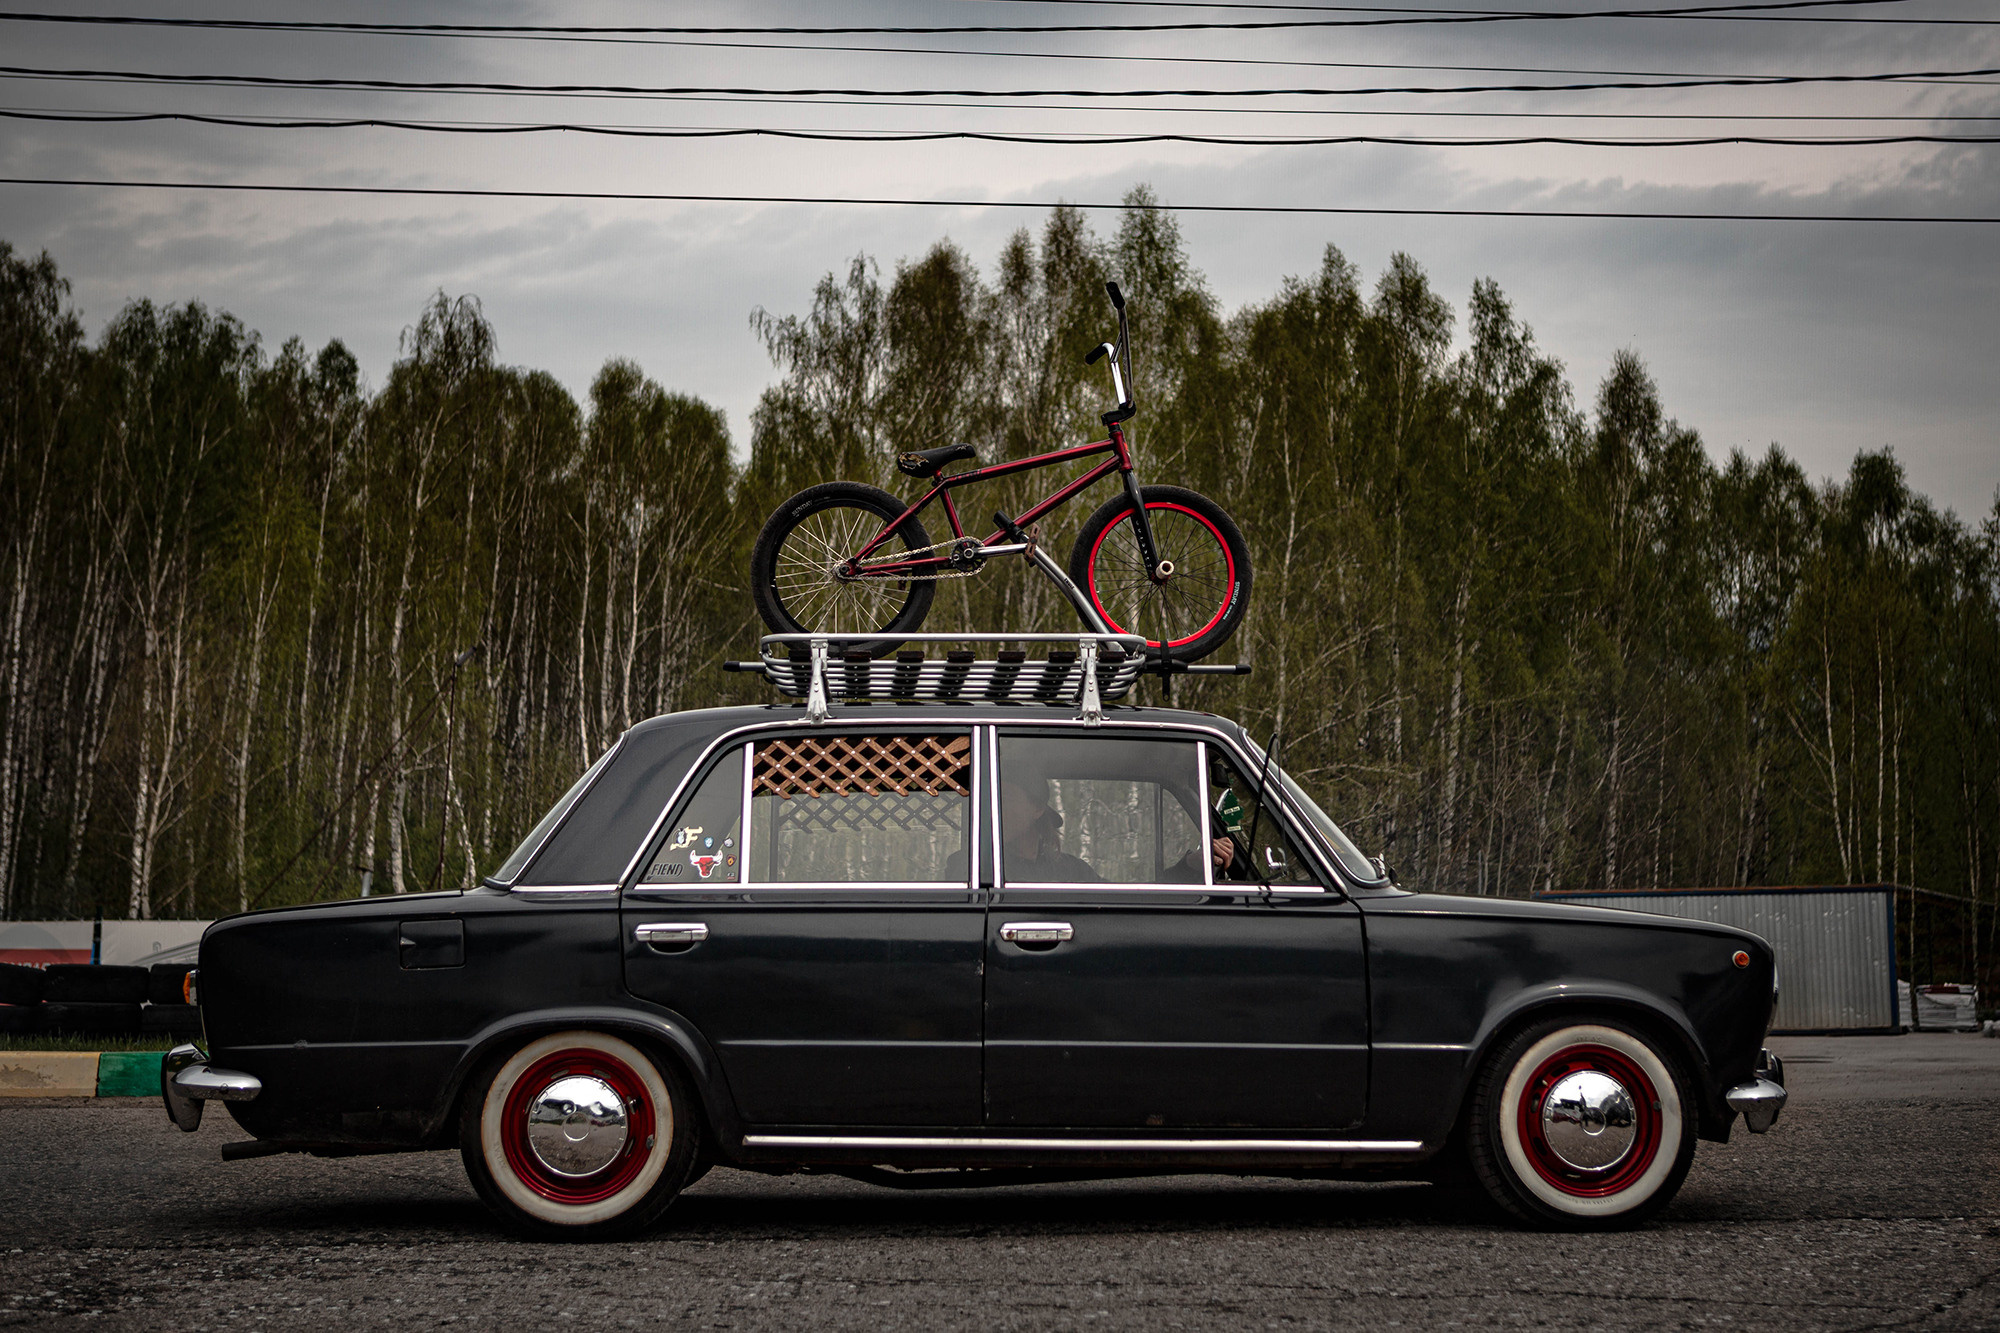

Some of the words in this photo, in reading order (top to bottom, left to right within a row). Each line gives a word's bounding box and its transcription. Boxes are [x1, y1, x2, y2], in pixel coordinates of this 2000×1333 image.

[791, 499, 813, 516] SUNDAY
[1230, 581, 1241, 605] SUNDAY
[651, 864, 683, 877] FIEND
